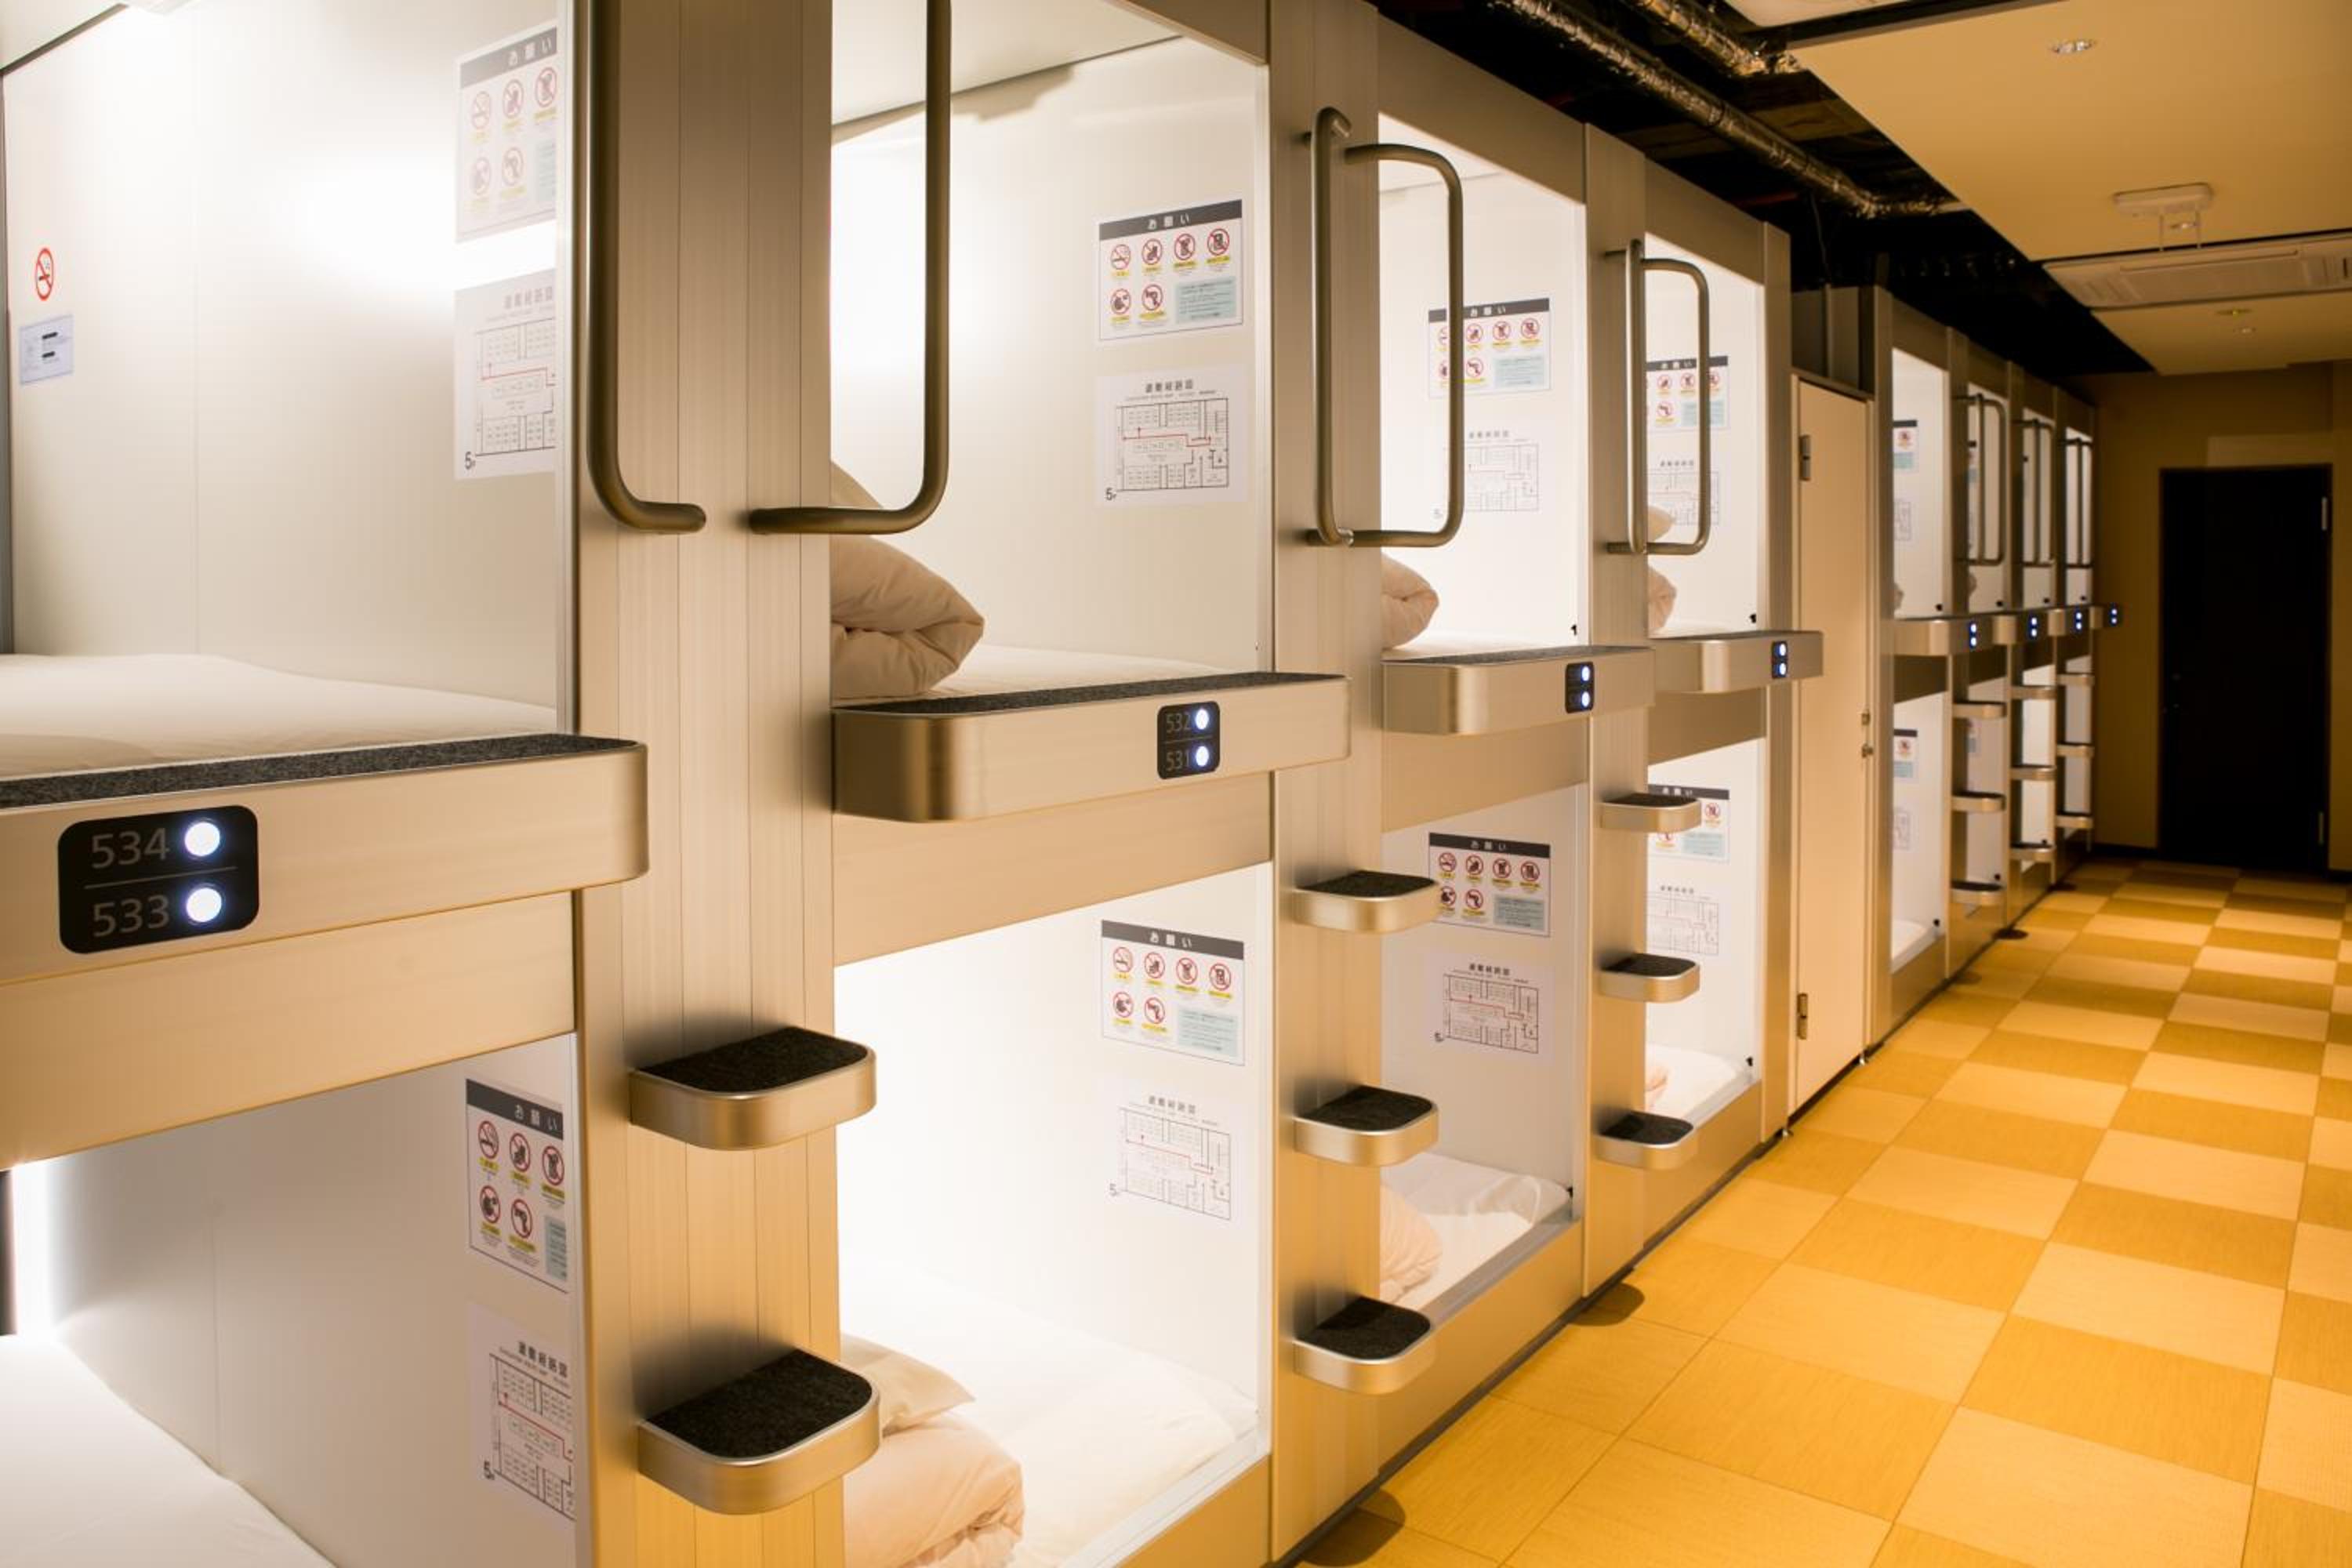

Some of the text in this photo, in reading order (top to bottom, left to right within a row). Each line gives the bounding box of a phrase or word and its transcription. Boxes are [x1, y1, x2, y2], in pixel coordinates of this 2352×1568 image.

[509, 37, 552, 66] おい
[1148, 213, 1189, 230] おい
[1166, 750, 1190, 771] 531
[91, 827, 170, 869] 534
[93, 895, 170, 938] 533
[1150, 931, 1192, 948] おい
